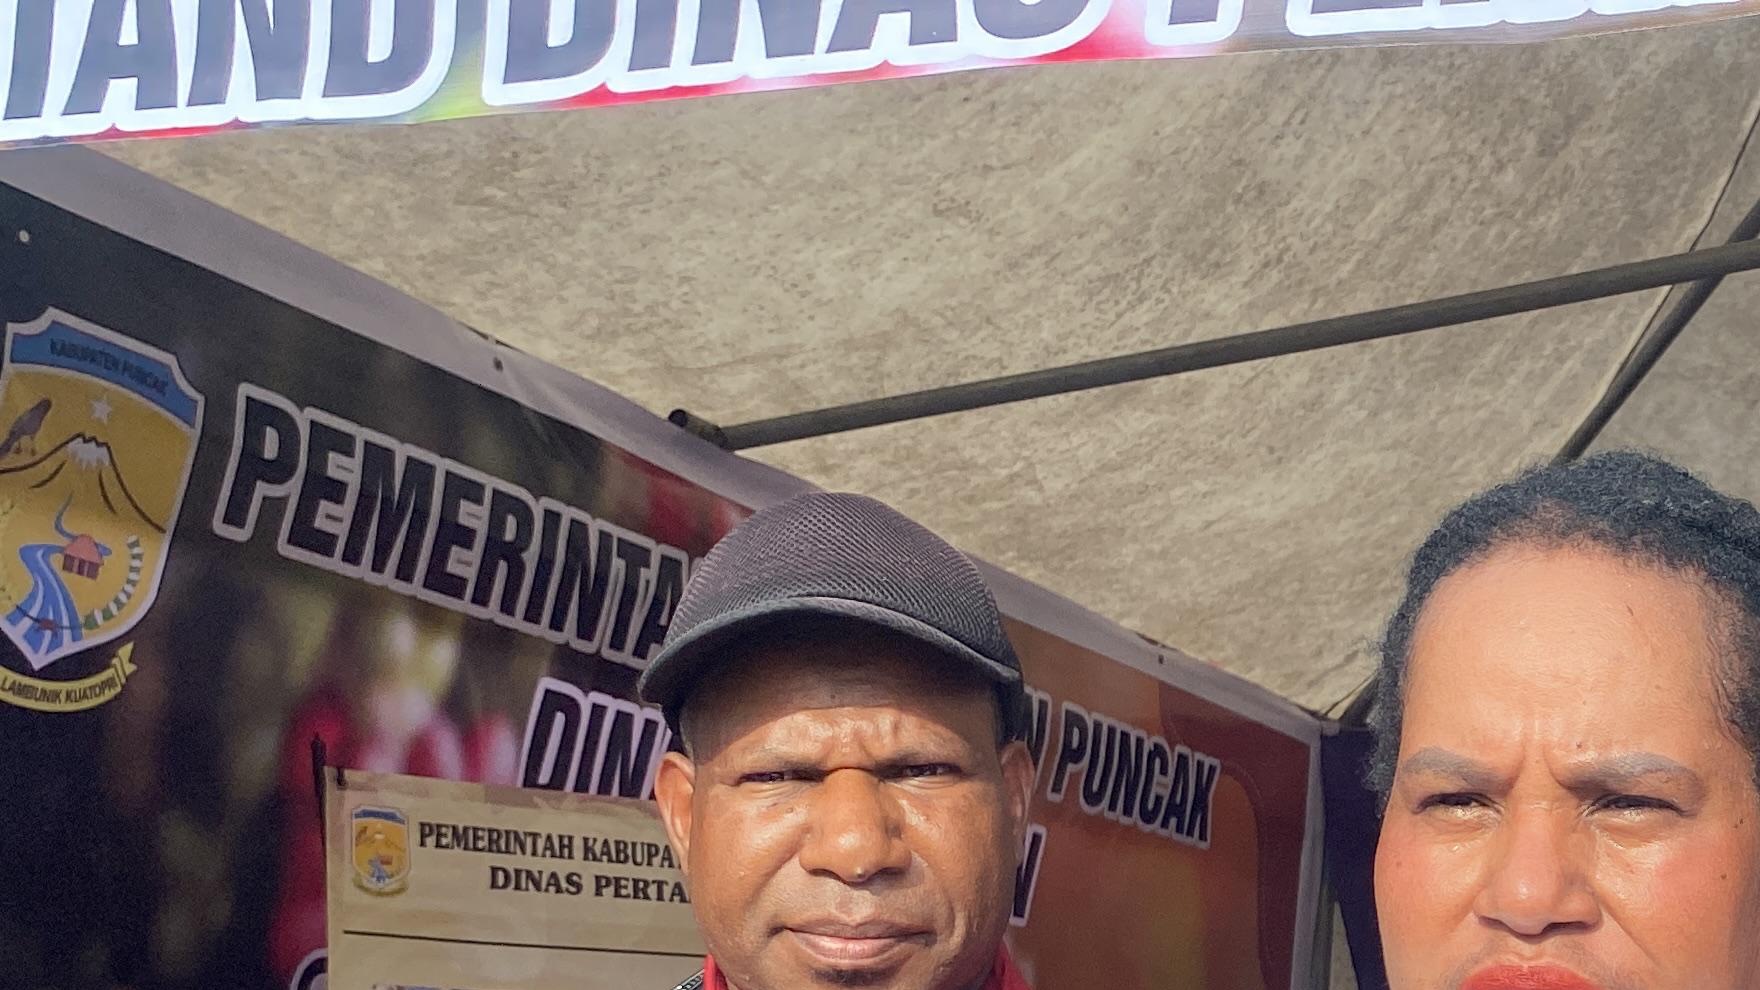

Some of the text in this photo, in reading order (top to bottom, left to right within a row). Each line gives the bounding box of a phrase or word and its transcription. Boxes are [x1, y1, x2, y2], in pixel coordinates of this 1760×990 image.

[217, 389, 1218, 842] PEMERINTA PUNCAK
[523, 687, 657, 799] DIN
[418, 821, 682, 869] PEMERINTAH KABUPA
[489, 866, 691, 904] DINAS PERTA
